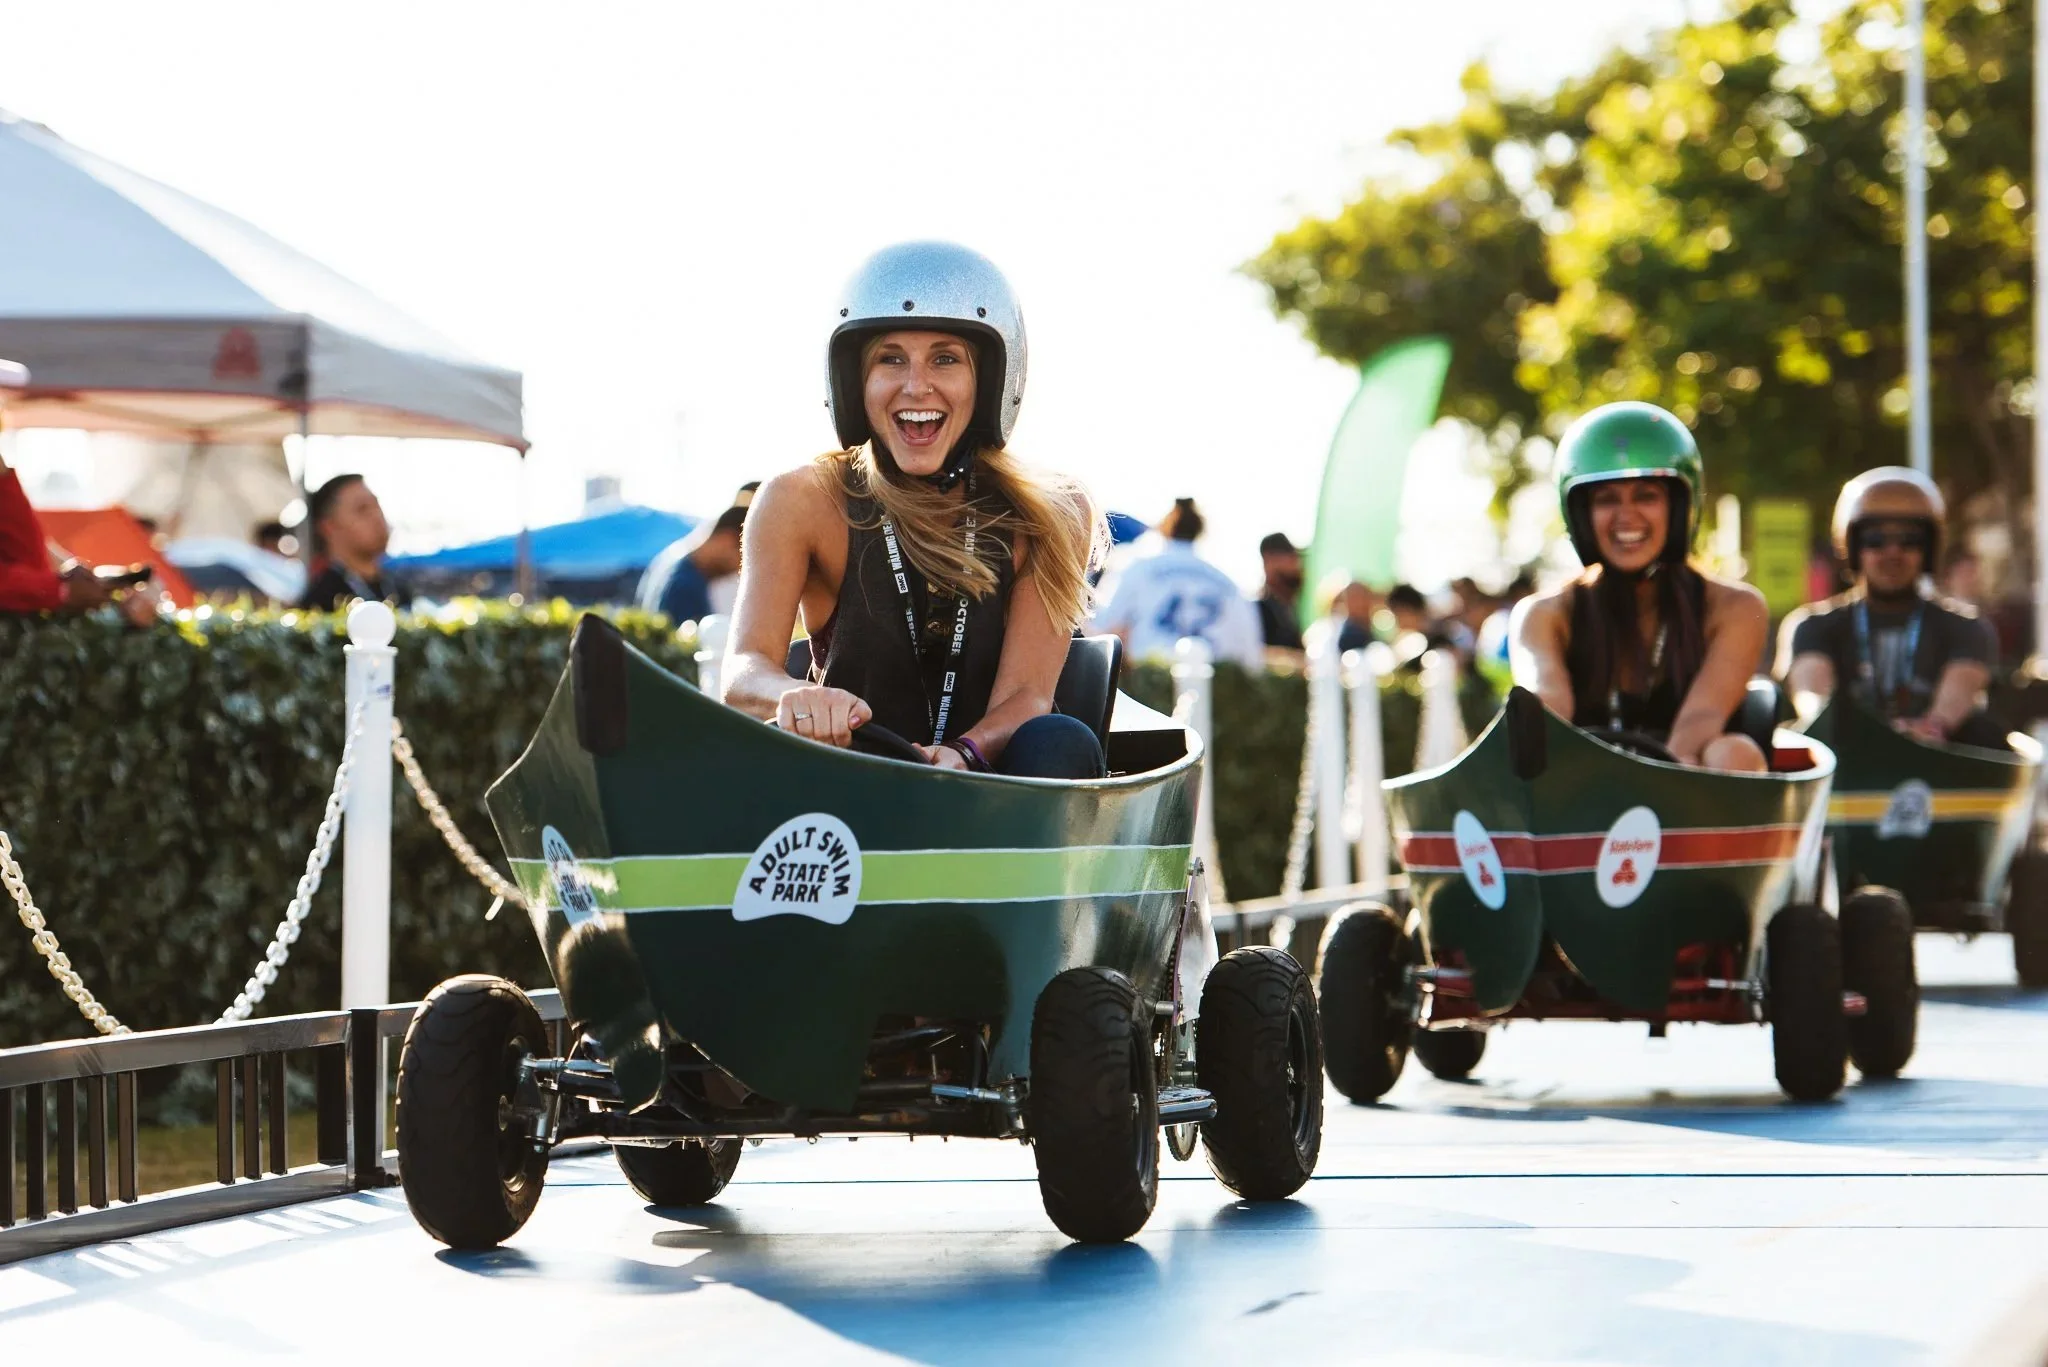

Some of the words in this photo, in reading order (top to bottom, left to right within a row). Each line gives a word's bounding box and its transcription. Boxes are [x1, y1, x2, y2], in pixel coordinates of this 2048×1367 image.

[885, 534, 903, 571] WALKING
[950, 599, 969, 656] OCTOBER
[935, 695, 952, 730] WALKING
[932, 730, 944, 746] DEA
[748, 826, 817, 895] ADULT
[817, 830, 851, 898] SWIM
[775, 863, 829, 883] STATE
[771, 883, 823, 903] PARK
